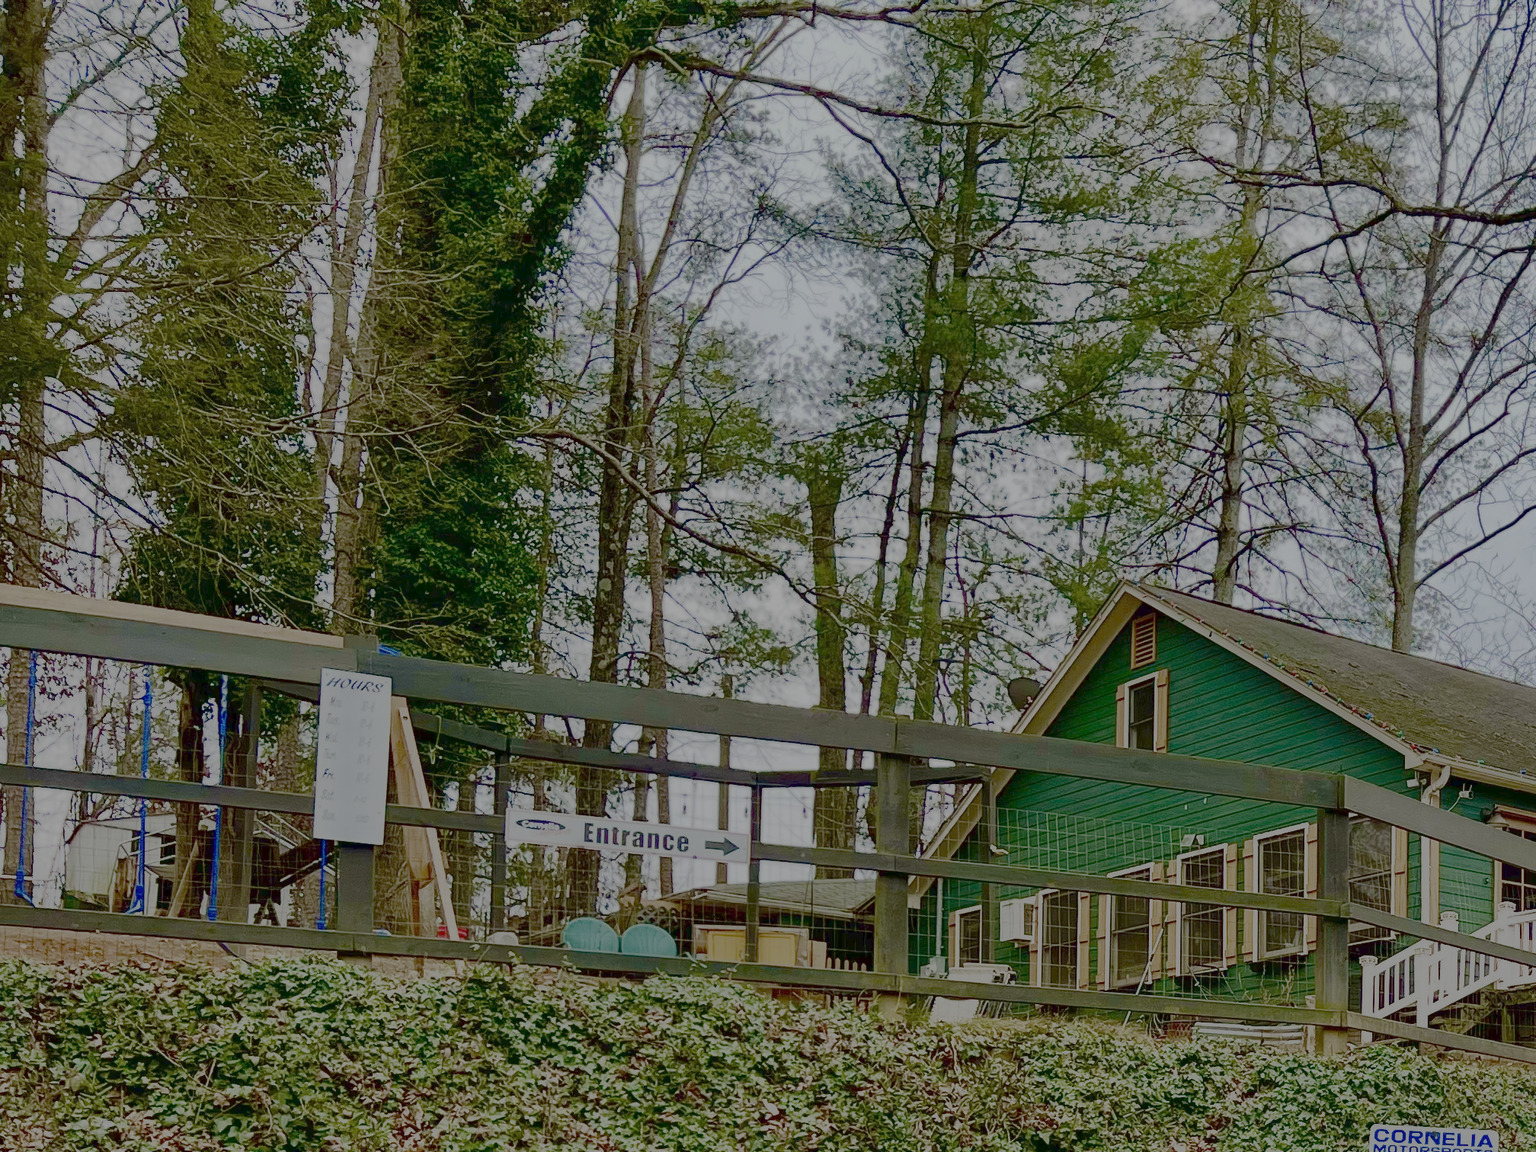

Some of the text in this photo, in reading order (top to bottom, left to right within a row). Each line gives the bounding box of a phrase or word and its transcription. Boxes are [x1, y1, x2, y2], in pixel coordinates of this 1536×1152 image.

[326, 677, 384, 693] HOURS
[584, 822, 689, 852] Entrance
[1374, 1128, 1493, 1148] CORNELIA
